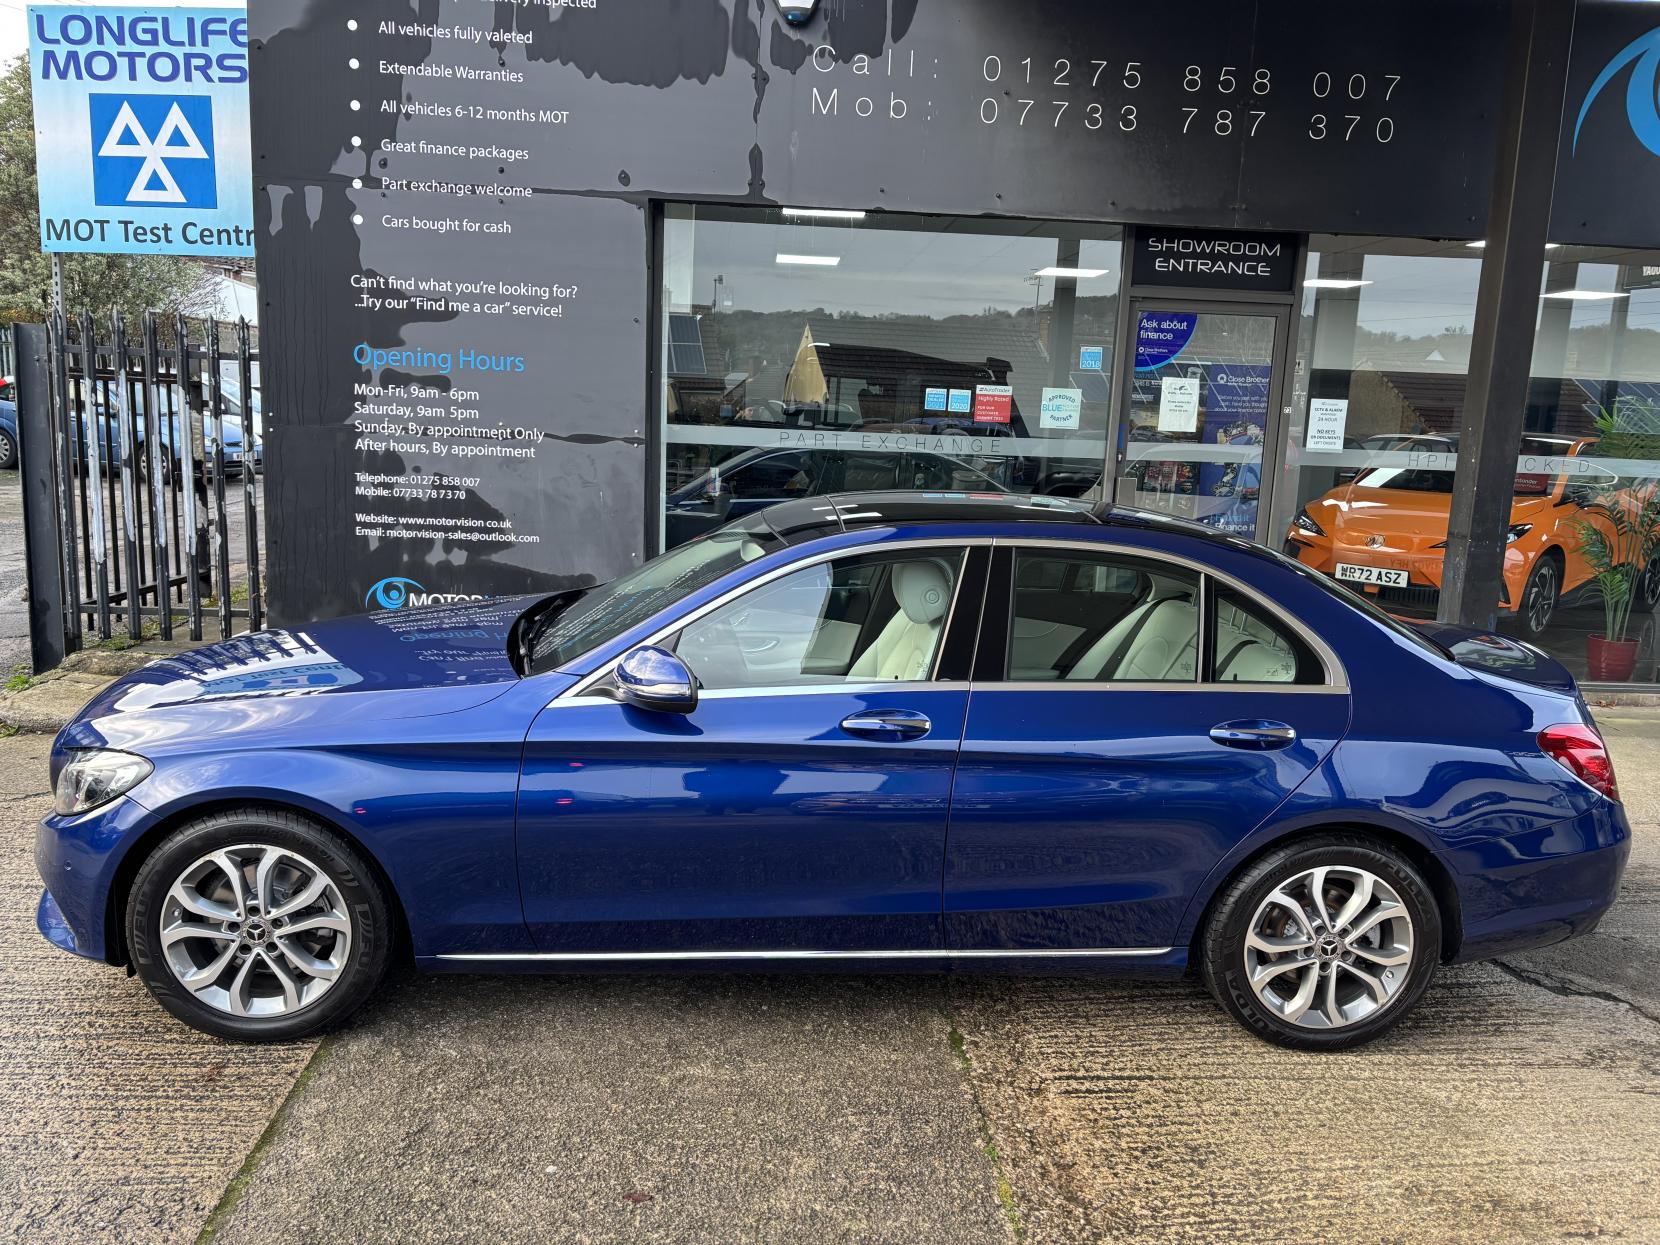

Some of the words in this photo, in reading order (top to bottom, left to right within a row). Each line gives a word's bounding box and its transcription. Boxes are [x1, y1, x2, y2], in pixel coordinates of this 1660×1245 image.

[36, 14, 247, 47] LONGLIFE
[379, 21, 396, 35] All
[399, 23, 450, 39] vehicles
[454, 26, 482, 44] fully
[486, 30, 532, 44] valeted
[42, 50, 247, 83] MOTORS
[379, 61, 452, 78] Extendable
[455, 66, 523, 82] Warranties
[812, 45, 938, 79] Call:
[982, 55, 1142, 89] 01275
[1184, 66, 1271, 95] 858
[1314, 72, 1401, 102] 007
[381, 100, 397, 112] All
[400, 102, 451, 116] vehicles
[455, 106, 483, 119] 6-12
[487, 109, 536, 122] months
[539, 111, 569, 123] MOT
[812, 87, 932, 121] Mob:
[980, 98, 1138, 132] 07733
[1182, 108, 1266, 138] 787
[1308, 114, 1394, 142] 370
[381, 139, 416, 152] Great
[419, 141, 466, 156] finance
[470, 144, 528, 160] packages
[382, 177, 408, 190] Part
[410, 179, 472, 196] exchange
[475, 183, 532, 198] welcome
[46, 219, 110, 241] MOT
[118, 220, 172, 244] Test
[182, 222, 254, 246] Centr
[382, 215, 409, 228] Cars
[412, 217, 460, 232] bought
[463, 219, 480, 232] for
[484, 221, 511, 234] cash
[1148, 238, 1280, 256] SHOWROOM
[1155, 258, 1270, 275] ENTRANCE
[351, 275, 385, 288] Can't
[388, 276, 414, 290] find
[418, 278, 452, 292] what
[455, 281, 495, 295] you're
[500, 282, 549, 299] looking
[553, 284, 577, 298] for?
[385, 299, 408, 309] our
[449, 302, 470, 312] me
[473, 303, 480, 312] a
[513, 304, 562, 317] service!
[1141, 319, 1158, 328] Ask
[1161, 320, 1187, 329] about
[1140, 331, 1173, 339] finance
[354, 344, 451, 373] Opening
[460, 348, 525, 372] Hours
[354, 384, 407, 399] Mon-Fri,
[411, 387, 438, 398] 9am
[450, 389, 479, 402] 6pm
[1049, 395, 1075, 403] APPROVED
[354, 402, 414, 417] Saturday,
[417, 406, 444, 417] 9am
[450, 407, 478, 420] 5pm
[355, 420, 406, 436] Sunday,
[409, 423, 423, 437] By
[427, 426, 511, 440] appointment
[515, 428, 544, 443] Only
[355, 439, 387, 451] After
[390, 440, 429, 454] hours,
[433, 442, 448, 456] By
[452, 444, 536, 458] appointment
[780, 432, 841, 446] PART
[862, 435, 1000, 452] EXCHANGE
[1408, 454, 1448, 468] HPI
[1525, 458, 1590, 473] CKED
[355, 473, 408, 484] Telephone:
[411, 476, 440, 485] 01275
[442, 476, 460, 486] 858
[463, 478, 480, 486] 007
[355, 487, 391, 496] Mobile:
[394, 488, 422, 498] 07733
[355, 513, 396, 523] Website:
[356, 527, 385, 536] Email:
[387, 529, 539, 542] motorvision-sales@outlook.com
[1341, 566, 1372, 580] WR72
[1376, 571, 1401, 584] ASZ
